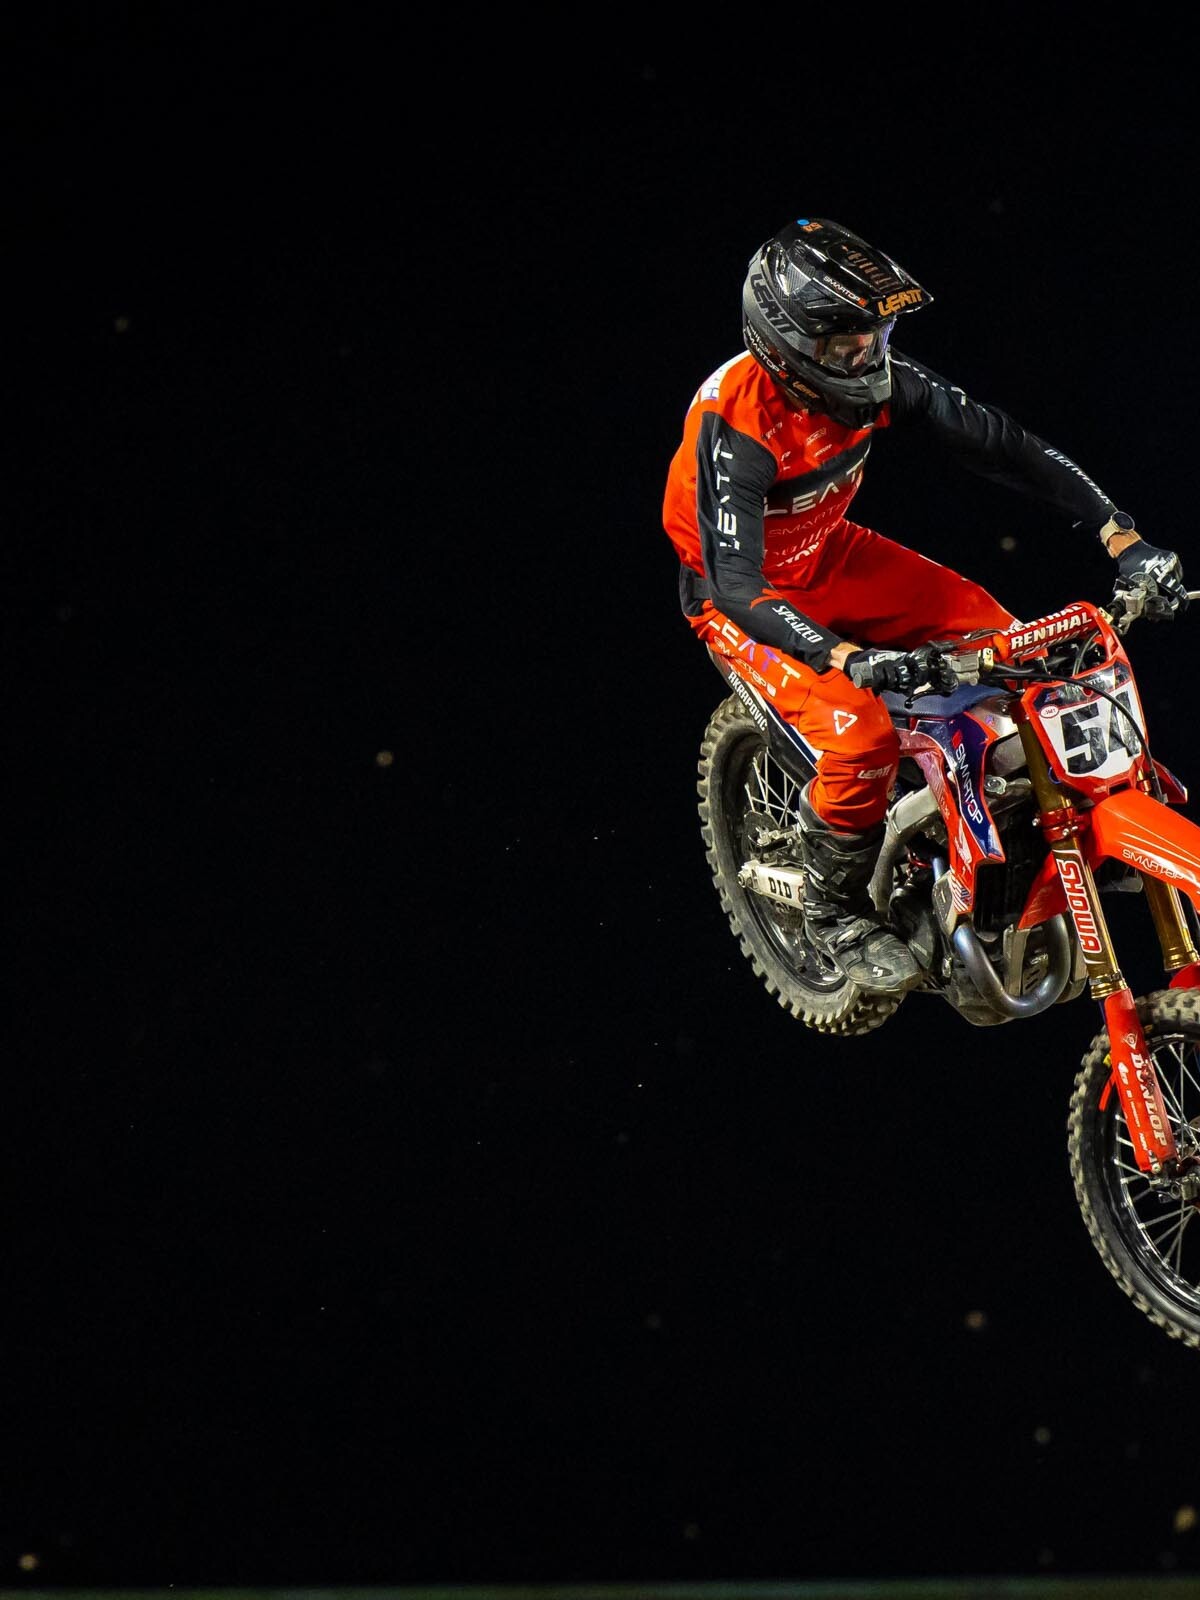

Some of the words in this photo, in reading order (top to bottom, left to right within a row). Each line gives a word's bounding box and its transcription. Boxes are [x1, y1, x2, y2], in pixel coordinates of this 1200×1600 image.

[751, 273, 804, 334] LEATT
[878, 289, 922, 316] LEATT
[1010, 612, 1092, 650] RENTHAL
[1060, 690, 1141, 774] 54
[857, 763, 893, 780] LEATT
[955, 743, 984, 824] SMARTOP
[1122, 848, 1184, 880] SMARTOP
[768, 876, 792, 899] DID
[1056, 859, 1102, 953] SHOWA
